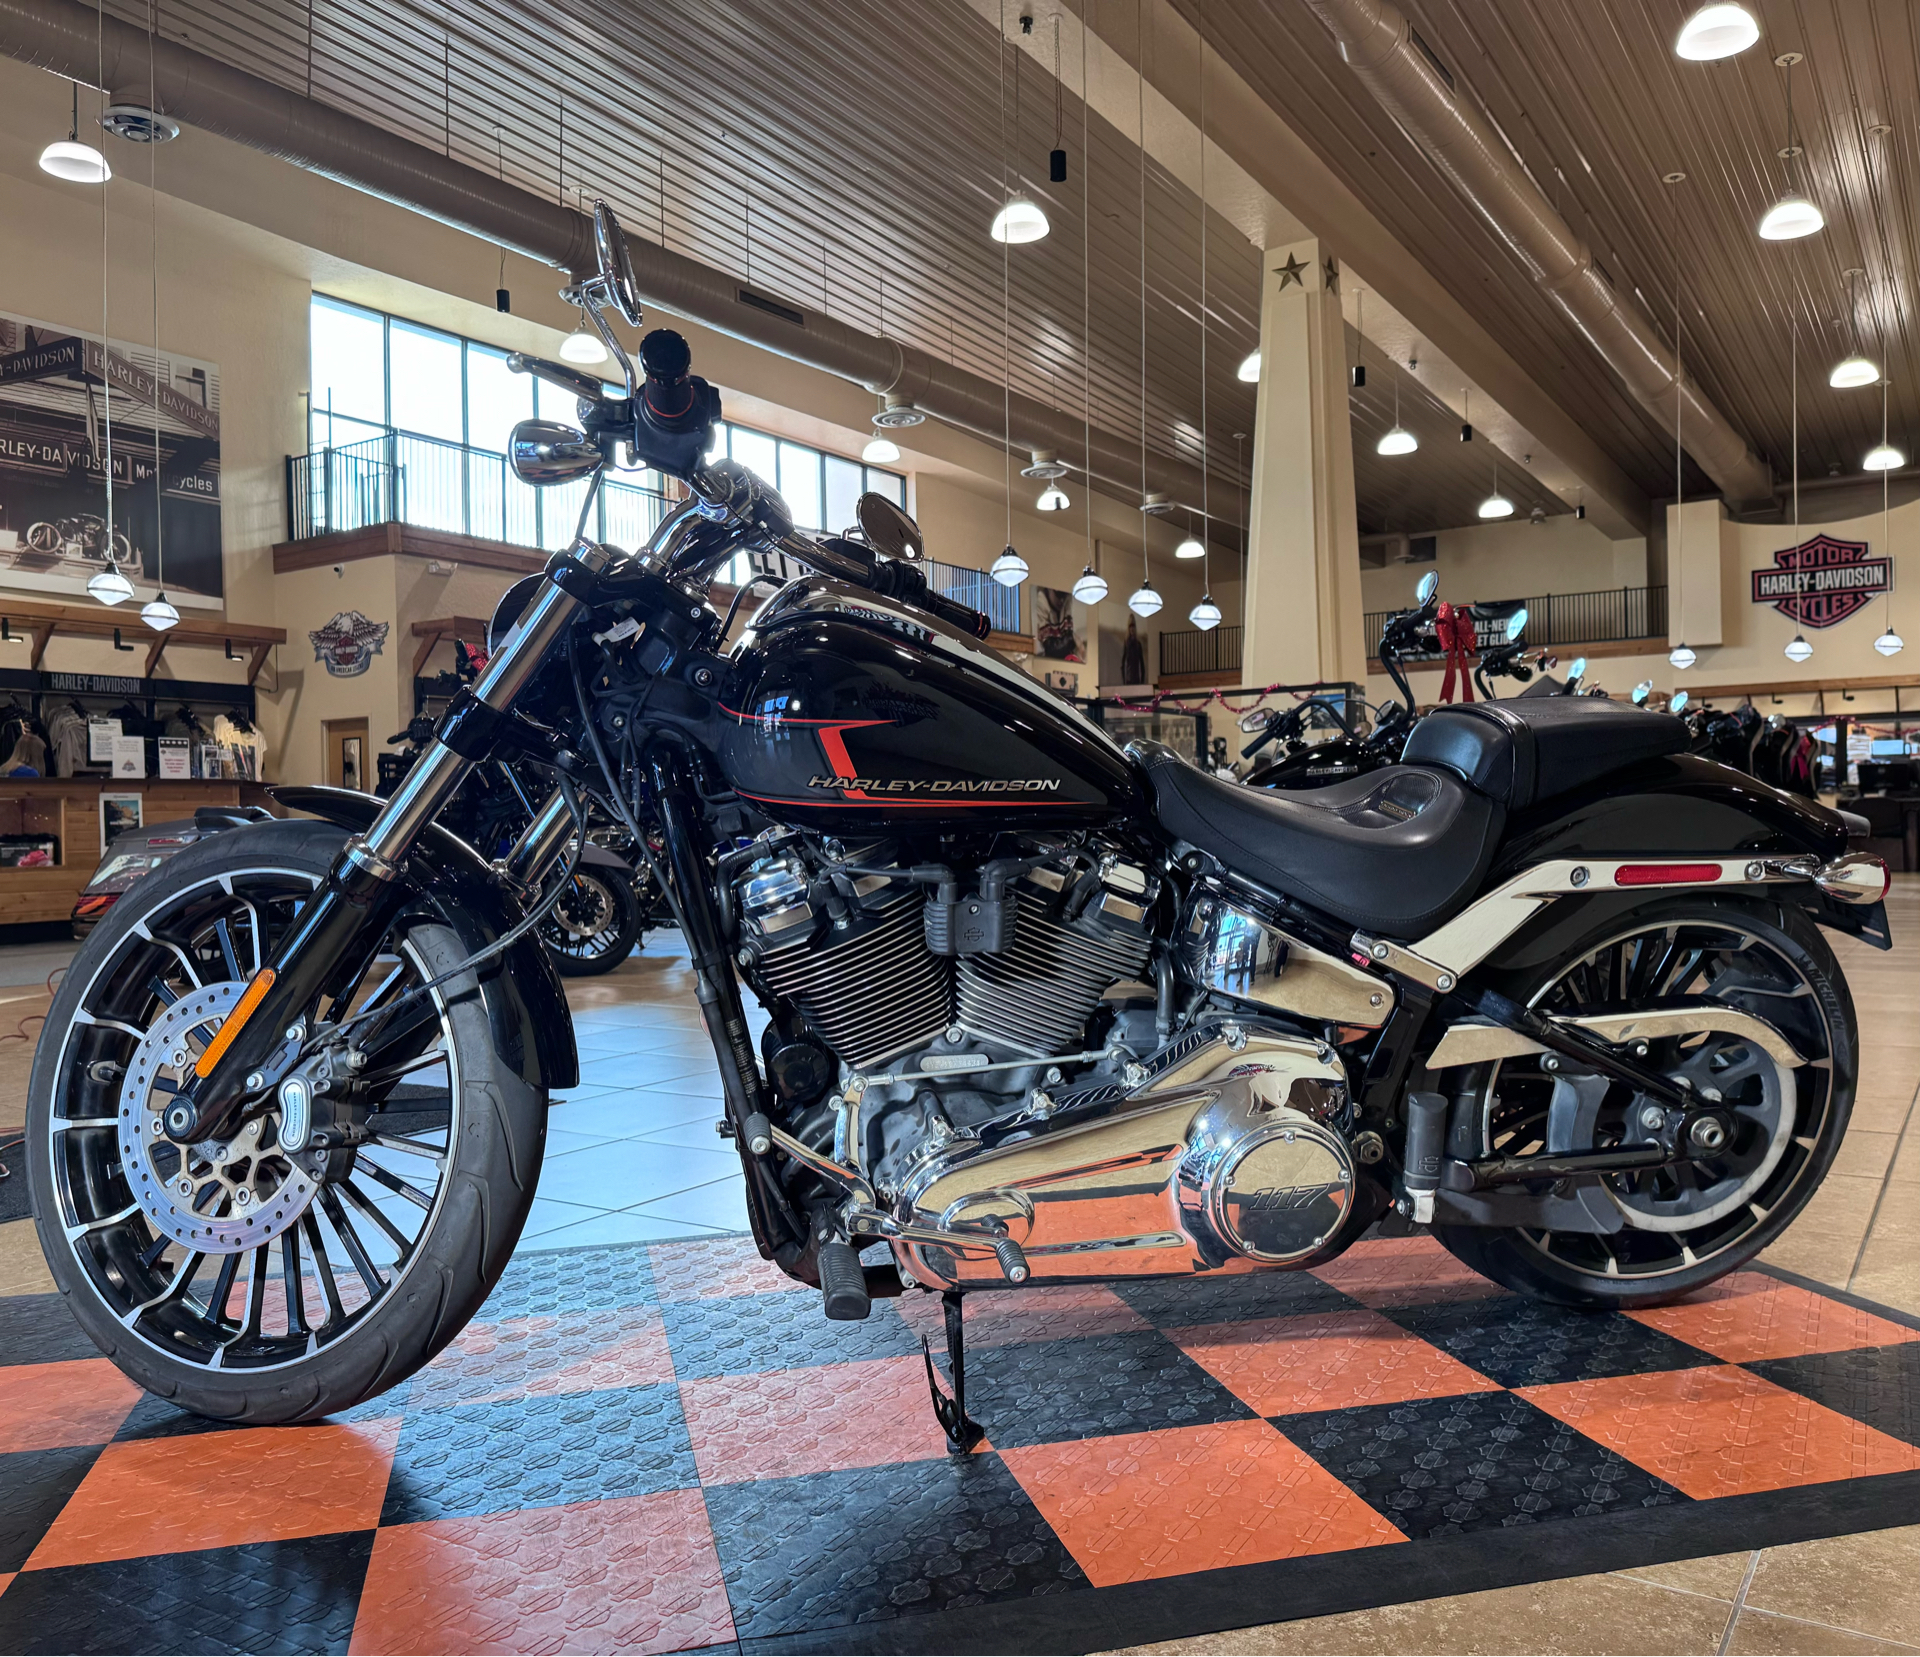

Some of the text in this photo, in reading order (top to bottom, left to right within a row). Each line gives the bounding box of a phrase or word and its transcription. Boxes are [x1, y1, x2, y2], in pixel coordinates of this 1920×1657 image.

[94, 351, 218, 431] HARLEY-DAVIDSON
[1788, 543, 1855, 568] MOTOR
[1760, 565, 1885, 596] HARLEY-DAVIDSON
[1788, 594, 1855, 621] CYCLES
[51, 673, 141, 694] HARLEY-DAVIDSON
[807, 774, 1062, 794] HARLEY-DAVIDSON
[1247, 1183, 1331, 1212] 117
